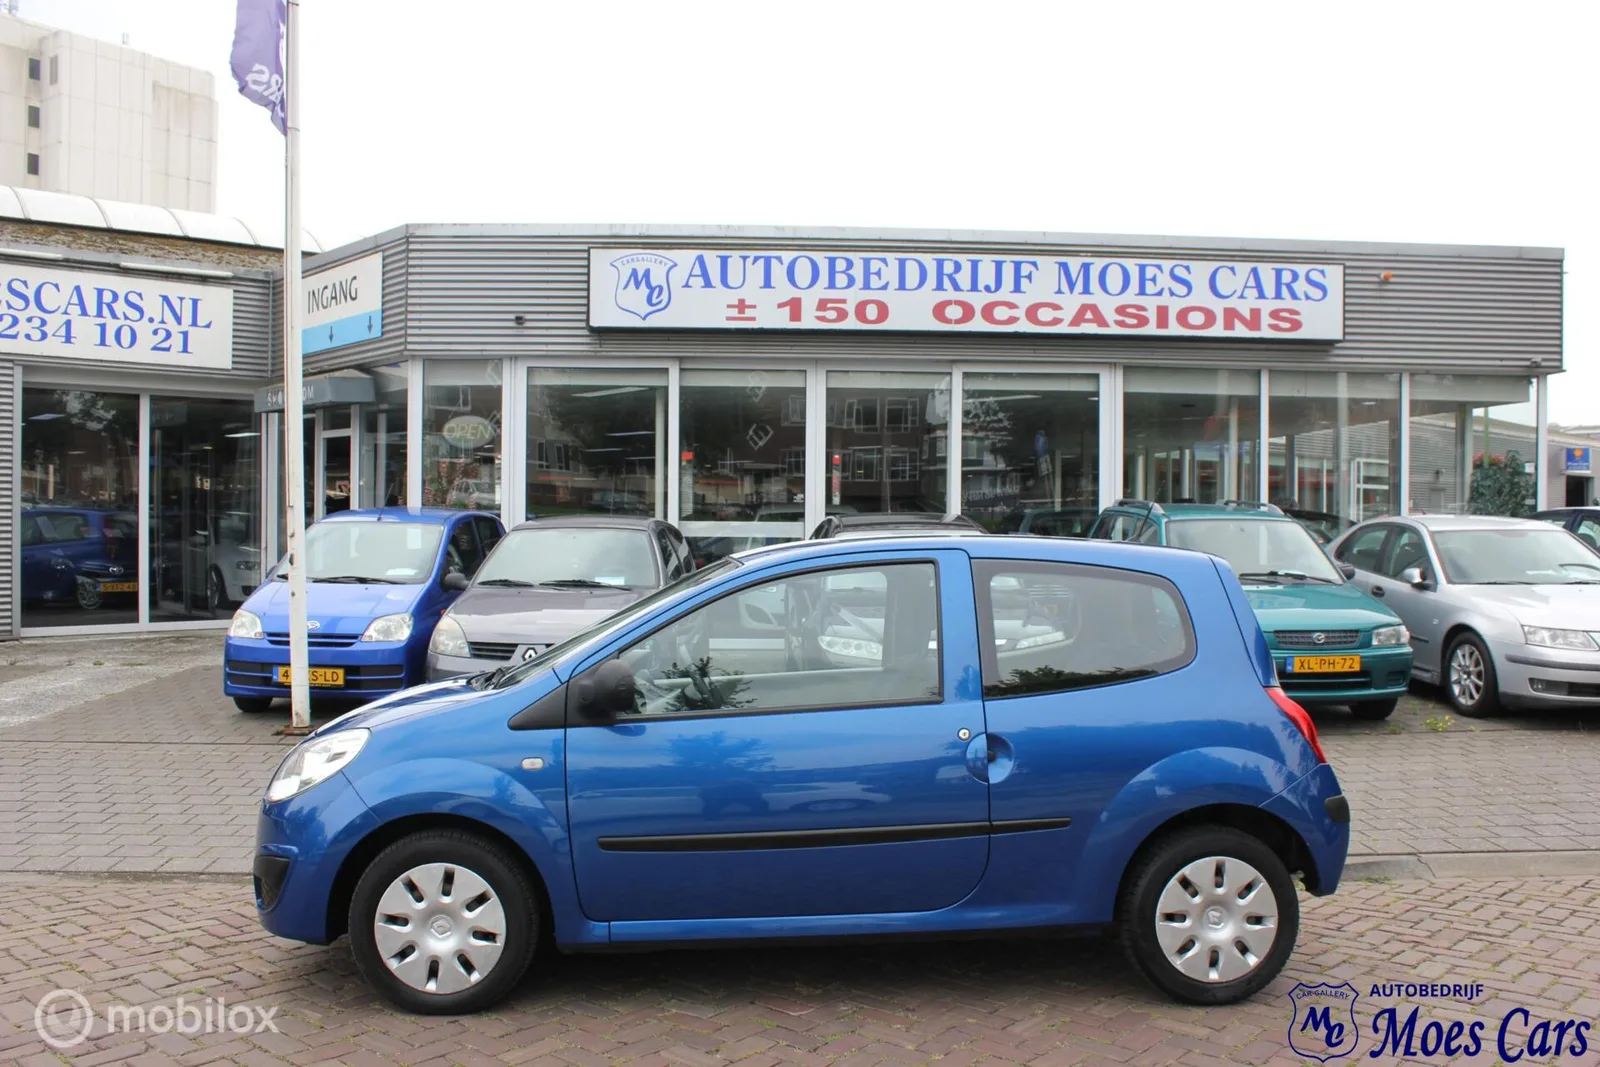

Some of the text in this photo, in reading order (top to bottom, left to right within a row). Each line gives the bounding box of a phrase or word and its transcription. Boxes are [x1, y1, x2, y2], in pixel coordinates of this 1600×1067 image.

[308, 275, 358, 314] INGANG
[681, 253, 1328, 302] AUTOBEDRIJF MOES CARS
[0, 278, 213, 329] SCARS.NL
[777, 297, 889, 324] 150
[932, 299, 1302, 332] OCCASIONS
[94, 323, 138, 350] 10
[151, 328, 194, 354] 21
[443, 423, 491, 439] OPEN
[1299, 658, 1355, 670] XL-PH-72
